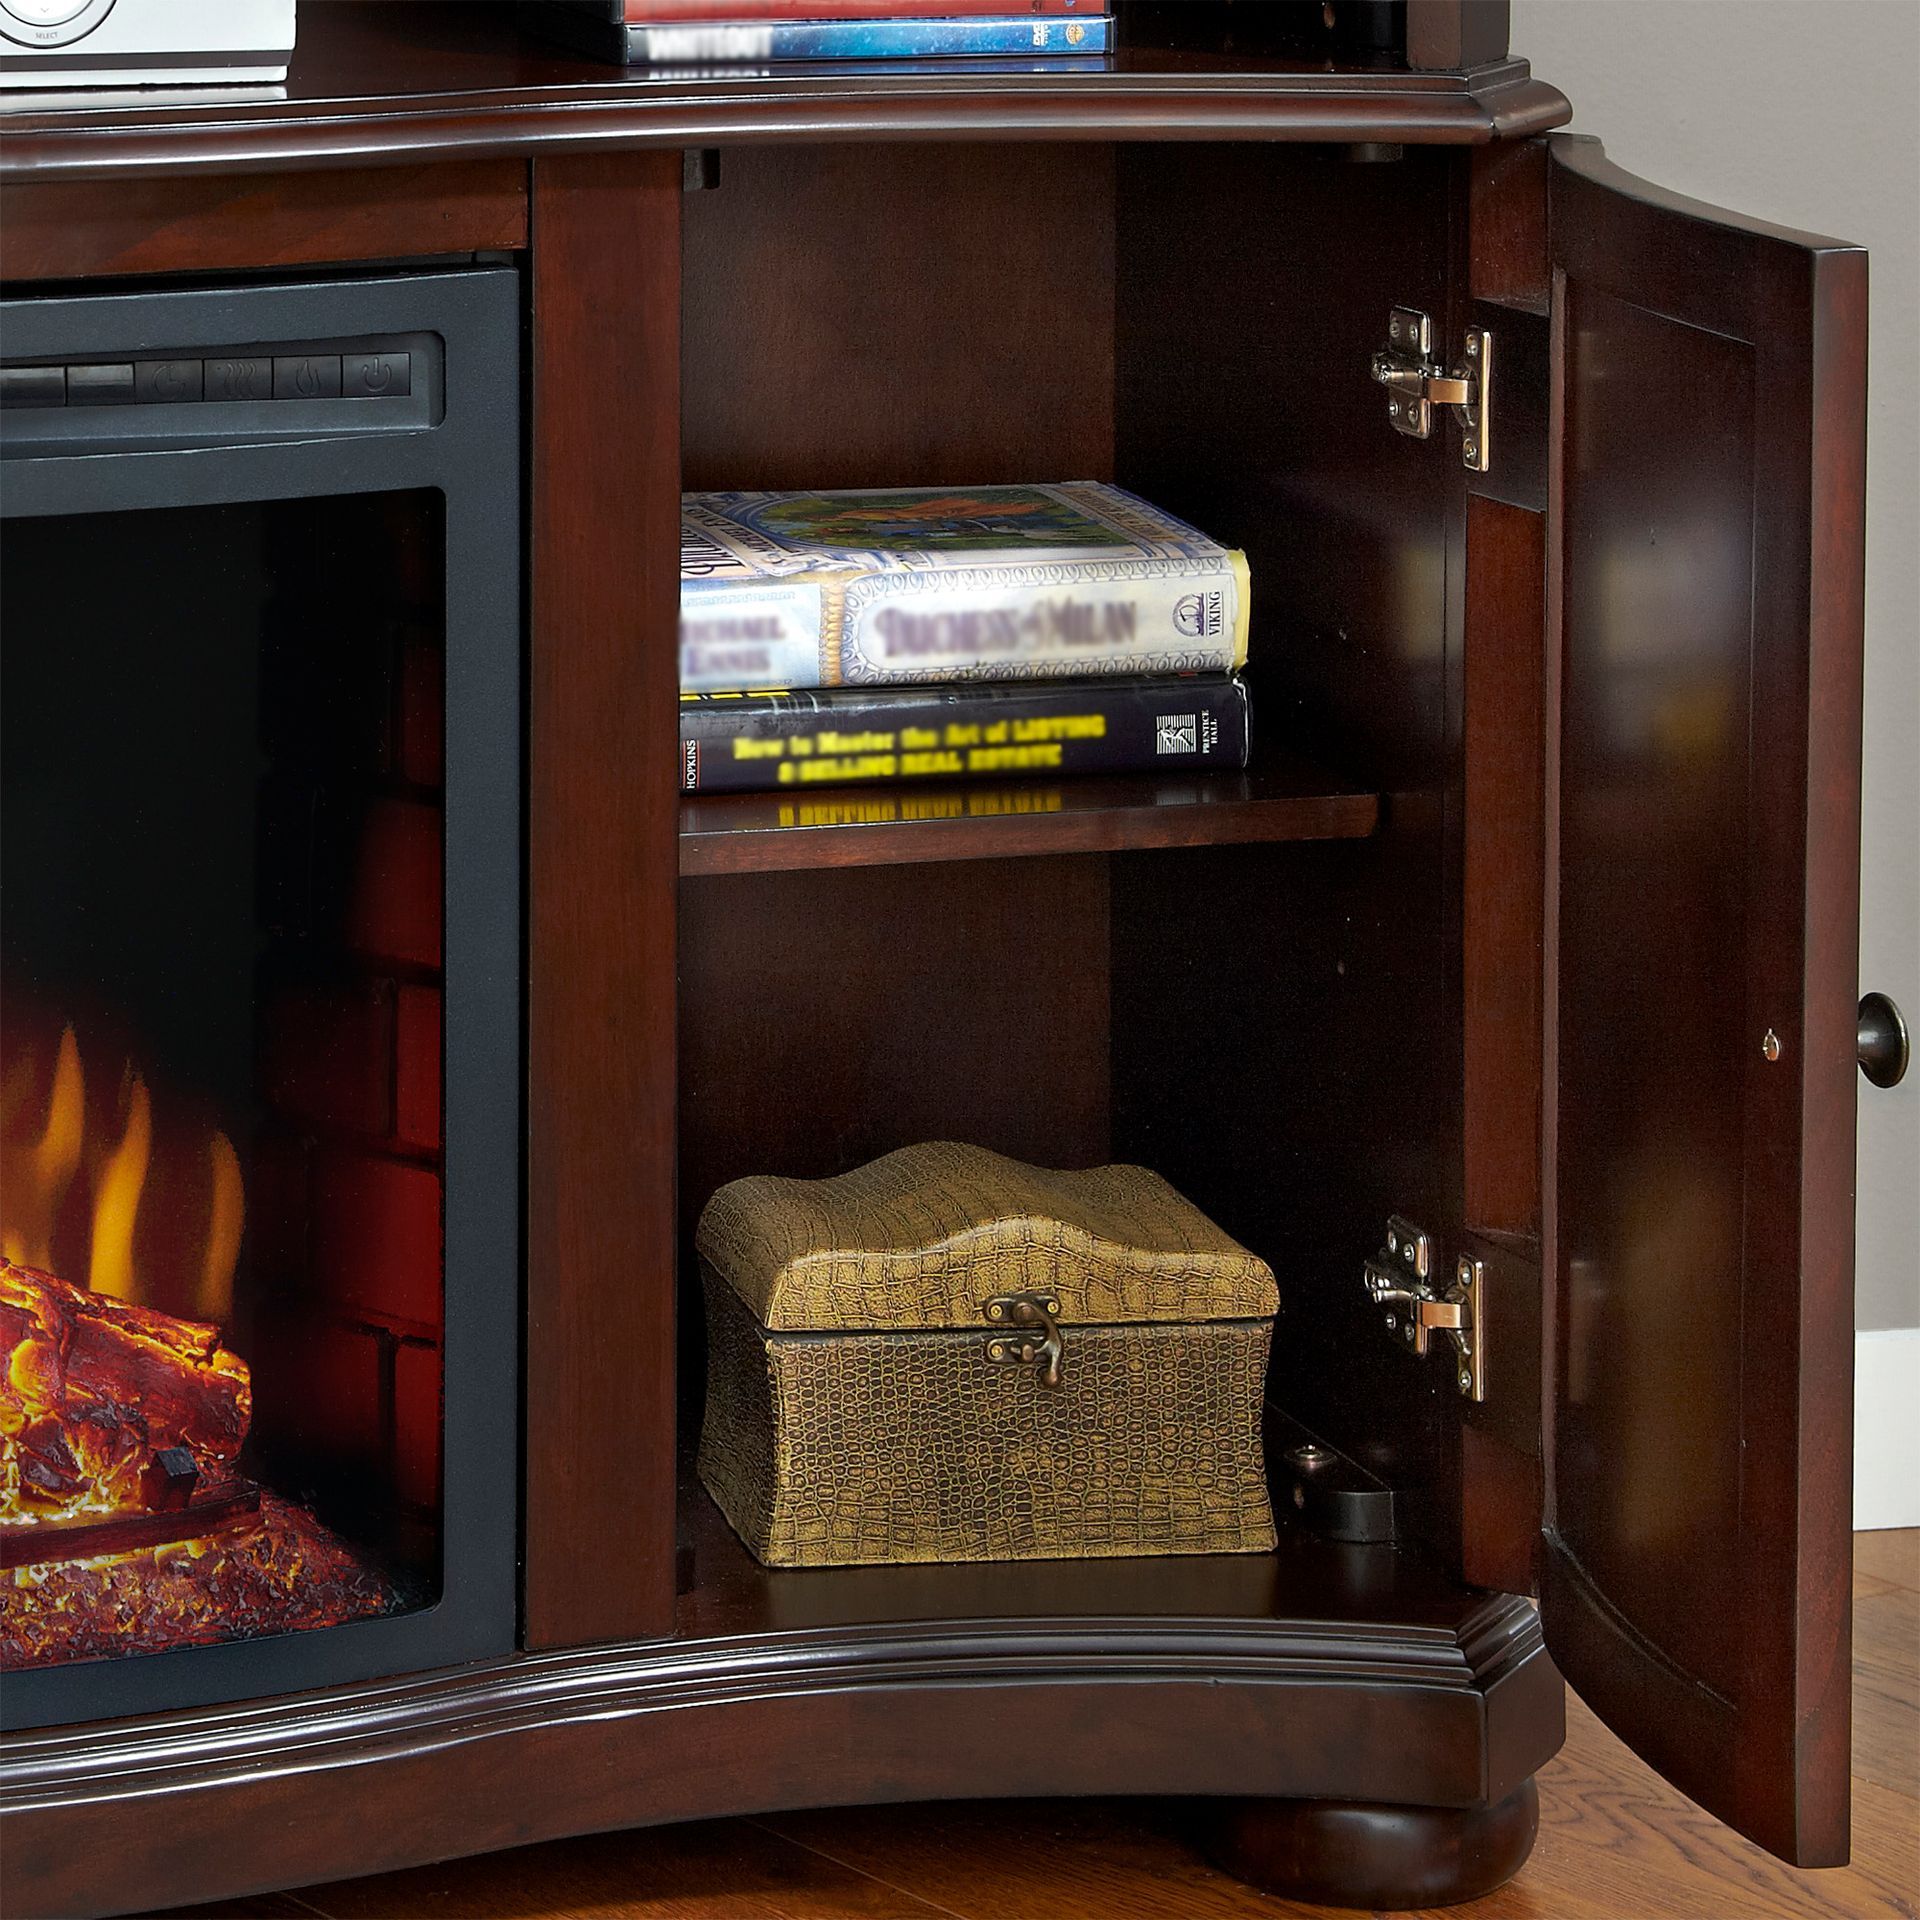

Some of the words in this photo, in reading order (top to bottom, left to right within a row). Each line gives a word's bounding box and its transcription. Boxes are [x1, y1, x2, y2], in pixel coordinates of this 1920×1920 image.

[35, 31, 58, 39] SELECT
[1209, 591, 1221, 636] VIKING
[1202, 710, 1210, 754] PRENTICE
[1210, 718, 1218, 744] HALL
[686, 739, 696, 789] HOPKINS
